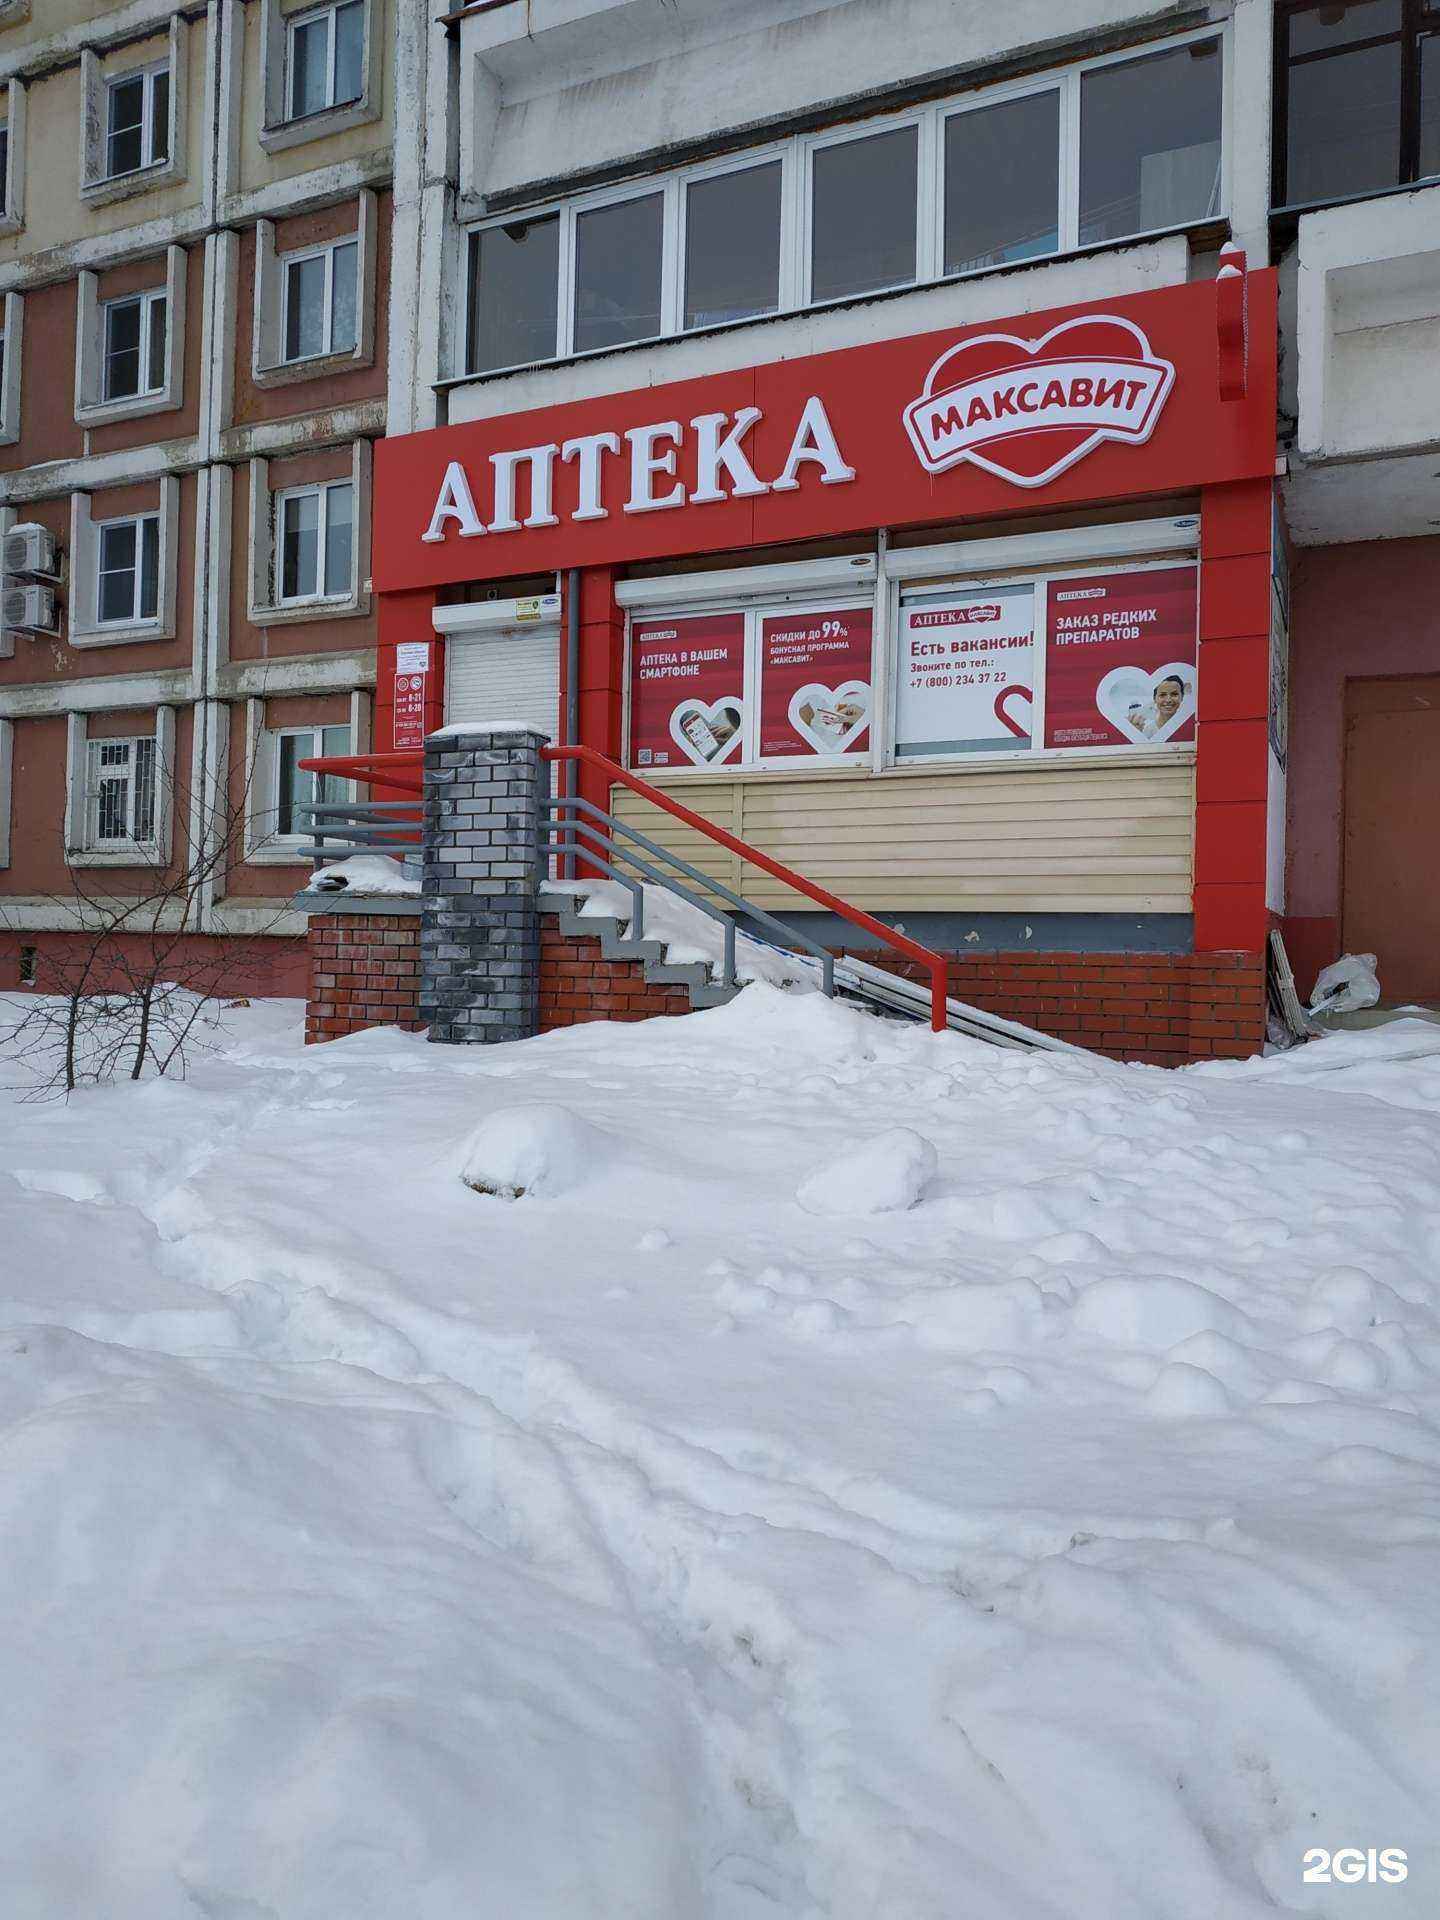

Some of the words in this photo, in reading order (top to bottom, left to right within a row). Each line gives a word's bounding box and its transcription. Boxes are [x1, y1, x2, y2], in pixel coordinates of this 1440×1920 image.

[930, 378, 1147, 441] МАКСАВИТ
[421, 395, 856, 543] АПТЕКА
[914, 612, 966, 626] АПТЕКА
[1056, 614, 1099, 630] ЗАКАЗ
[1103, 608, 1158, 627] РЕДКИХ
[770, 631, 806, 643] СКИДКИ
[808, 630, 821, 641] ДО
[911, 641, 946, 657] Есть
[951, 630, 1035, 653] вакансии!
[1056, 626, 1140, 646] ПРЕПАРАТОВ
[770, 646, 806, 655] БОНУСНАЯ
[807, 641, 850, 652] ПРОГРАММА
[639, 653, 678, 667] АПТЕКА
[680, 651, 688, 663] В
[690, 647, 728, 662] ВАШЕМ
[770, 654, 814, 665] «МАКСАВИТ»
[639, 664, 700, 680] СМАРТФОНЕ
[910, 661, 951, 673] Звоните
[954, 661, 967, 670] по
[970, 659, 995, 668] тел.:
[909, 678, 922, 688] +7
[925, 676, 952, 688] (800)
[955, 674, 975, 685] 234
[977, 672, 991, 684] 37
[993, 671, 1007, 682] 22
